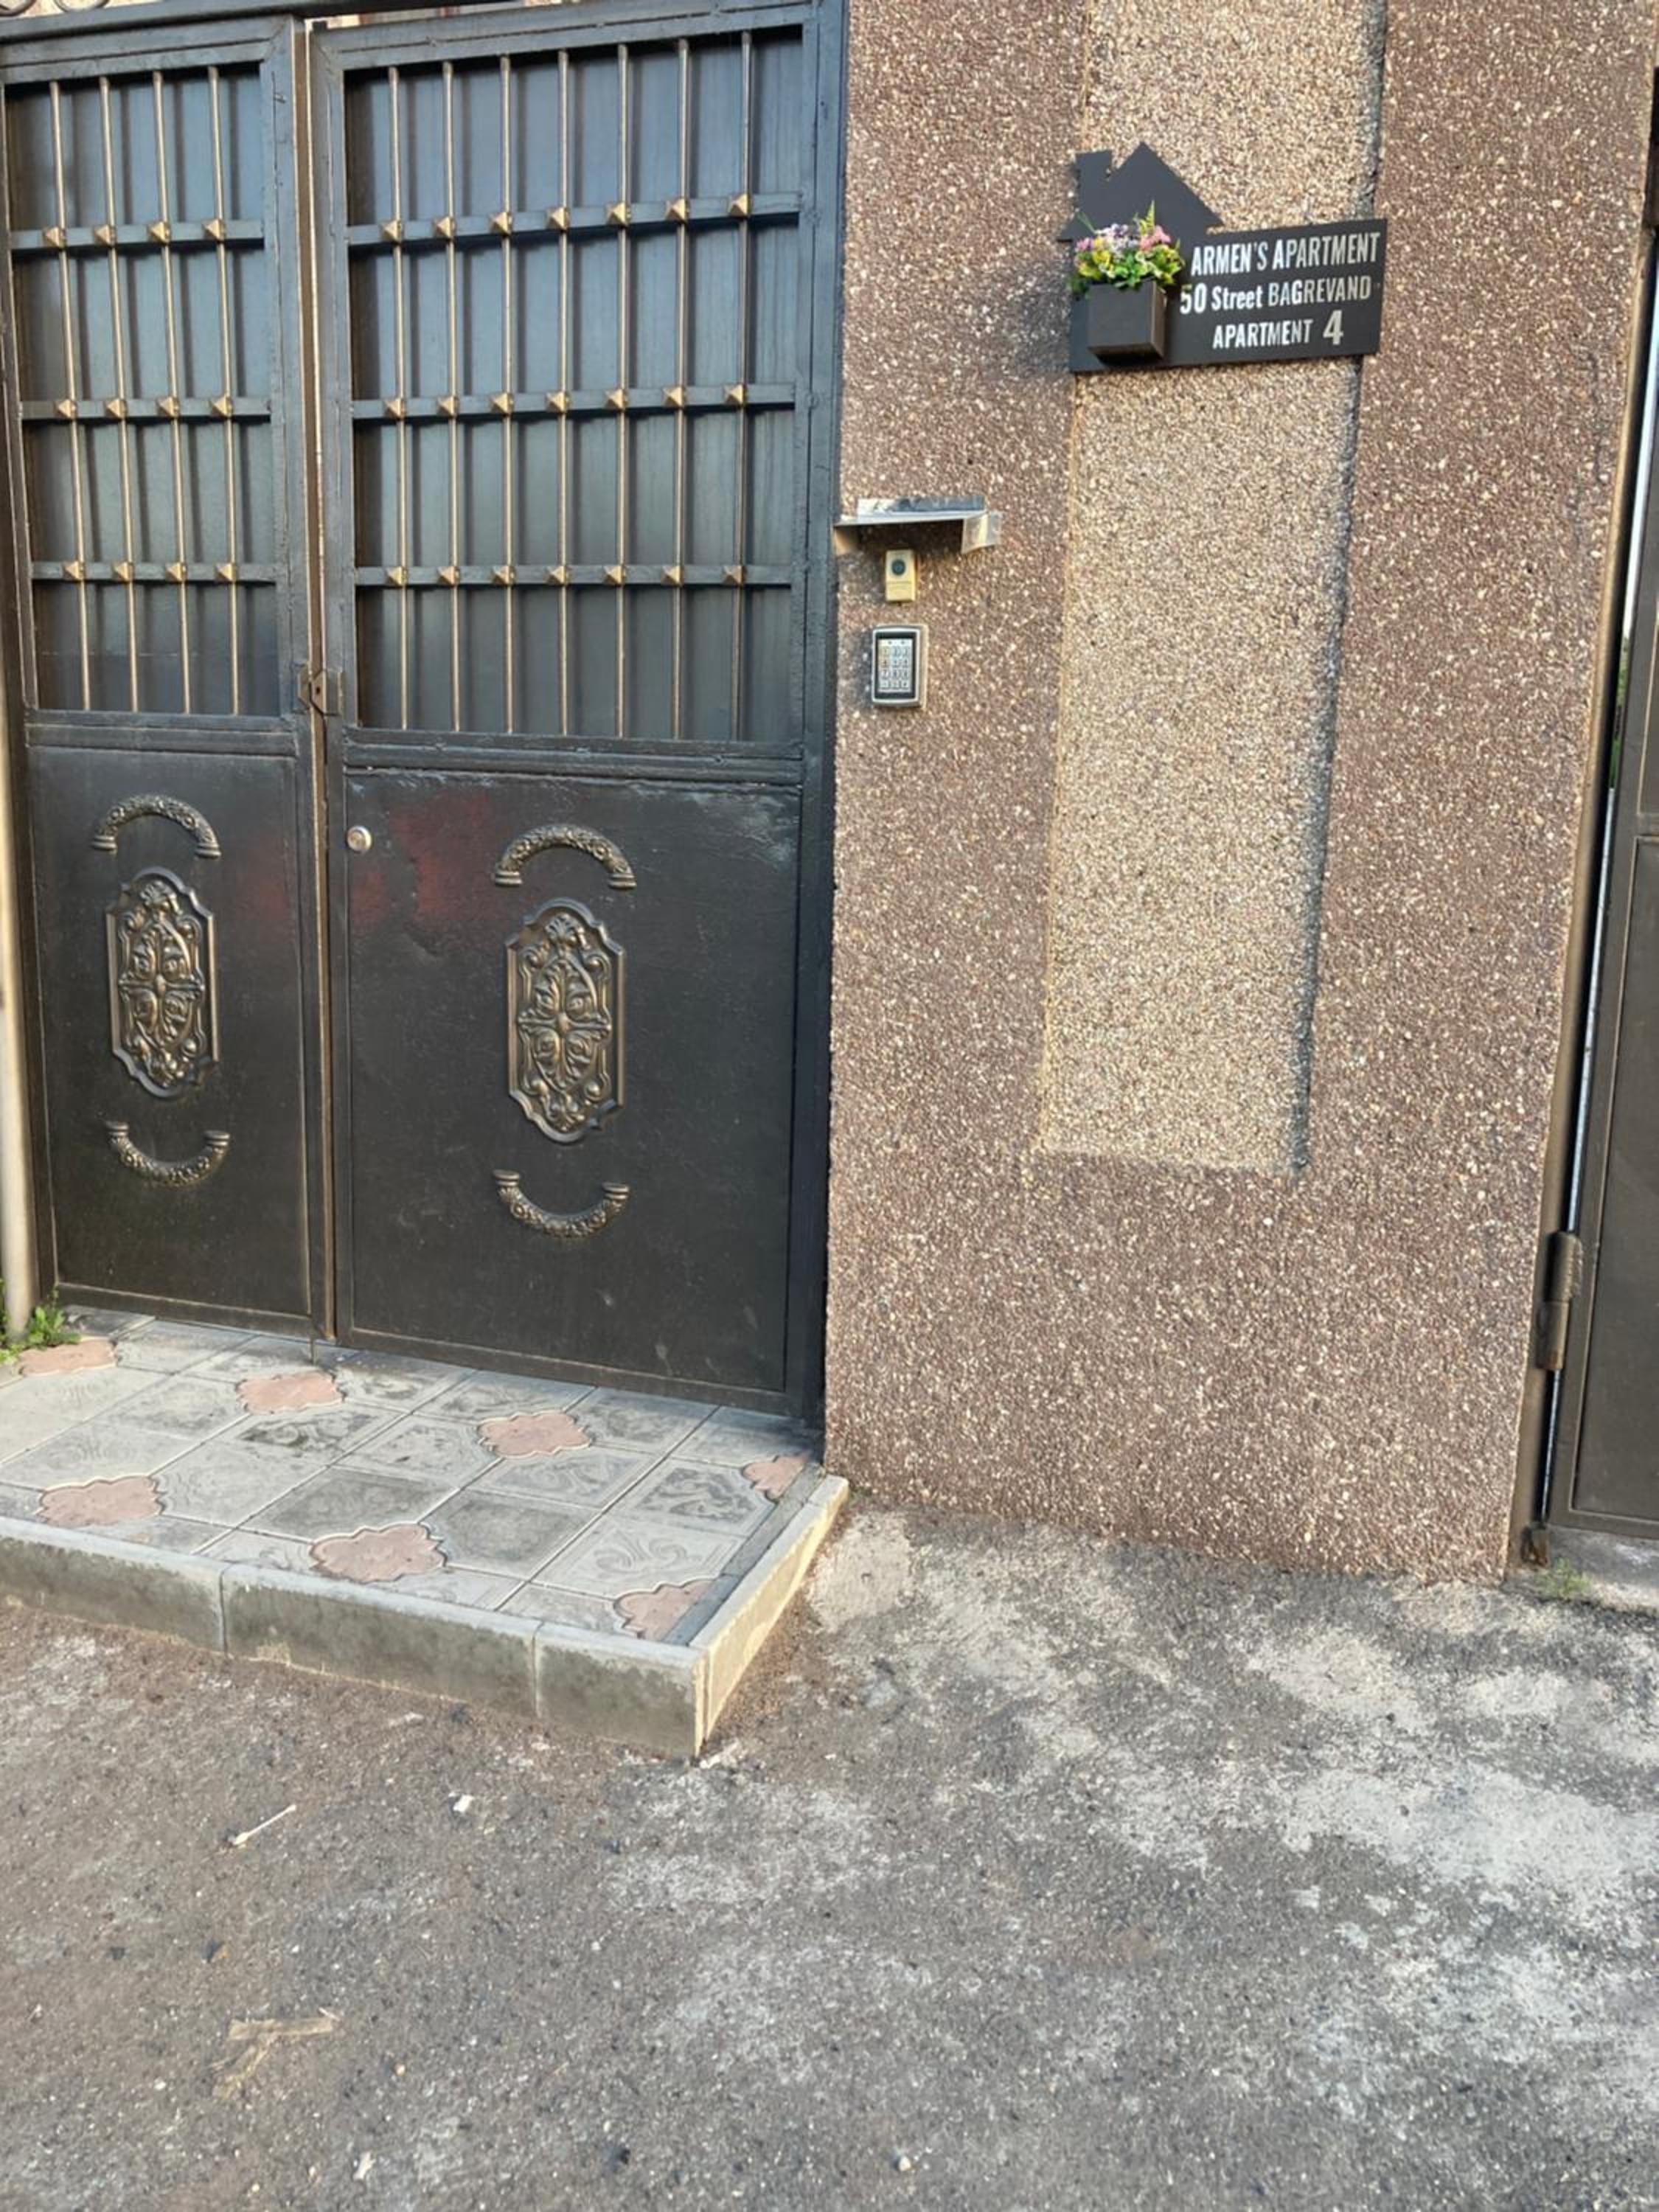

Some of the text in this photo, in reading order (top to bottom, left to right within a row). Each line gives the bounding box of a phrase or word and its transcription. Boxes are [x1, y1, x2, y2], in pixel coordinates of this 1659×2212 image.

[1191, 232, 1380, 276] ARMEN'S APARTMENT
[1180, 275, 1371, 314] 50 Street BAGREVAND
[1212, 309, 1343, 349] APARTMENT 4
